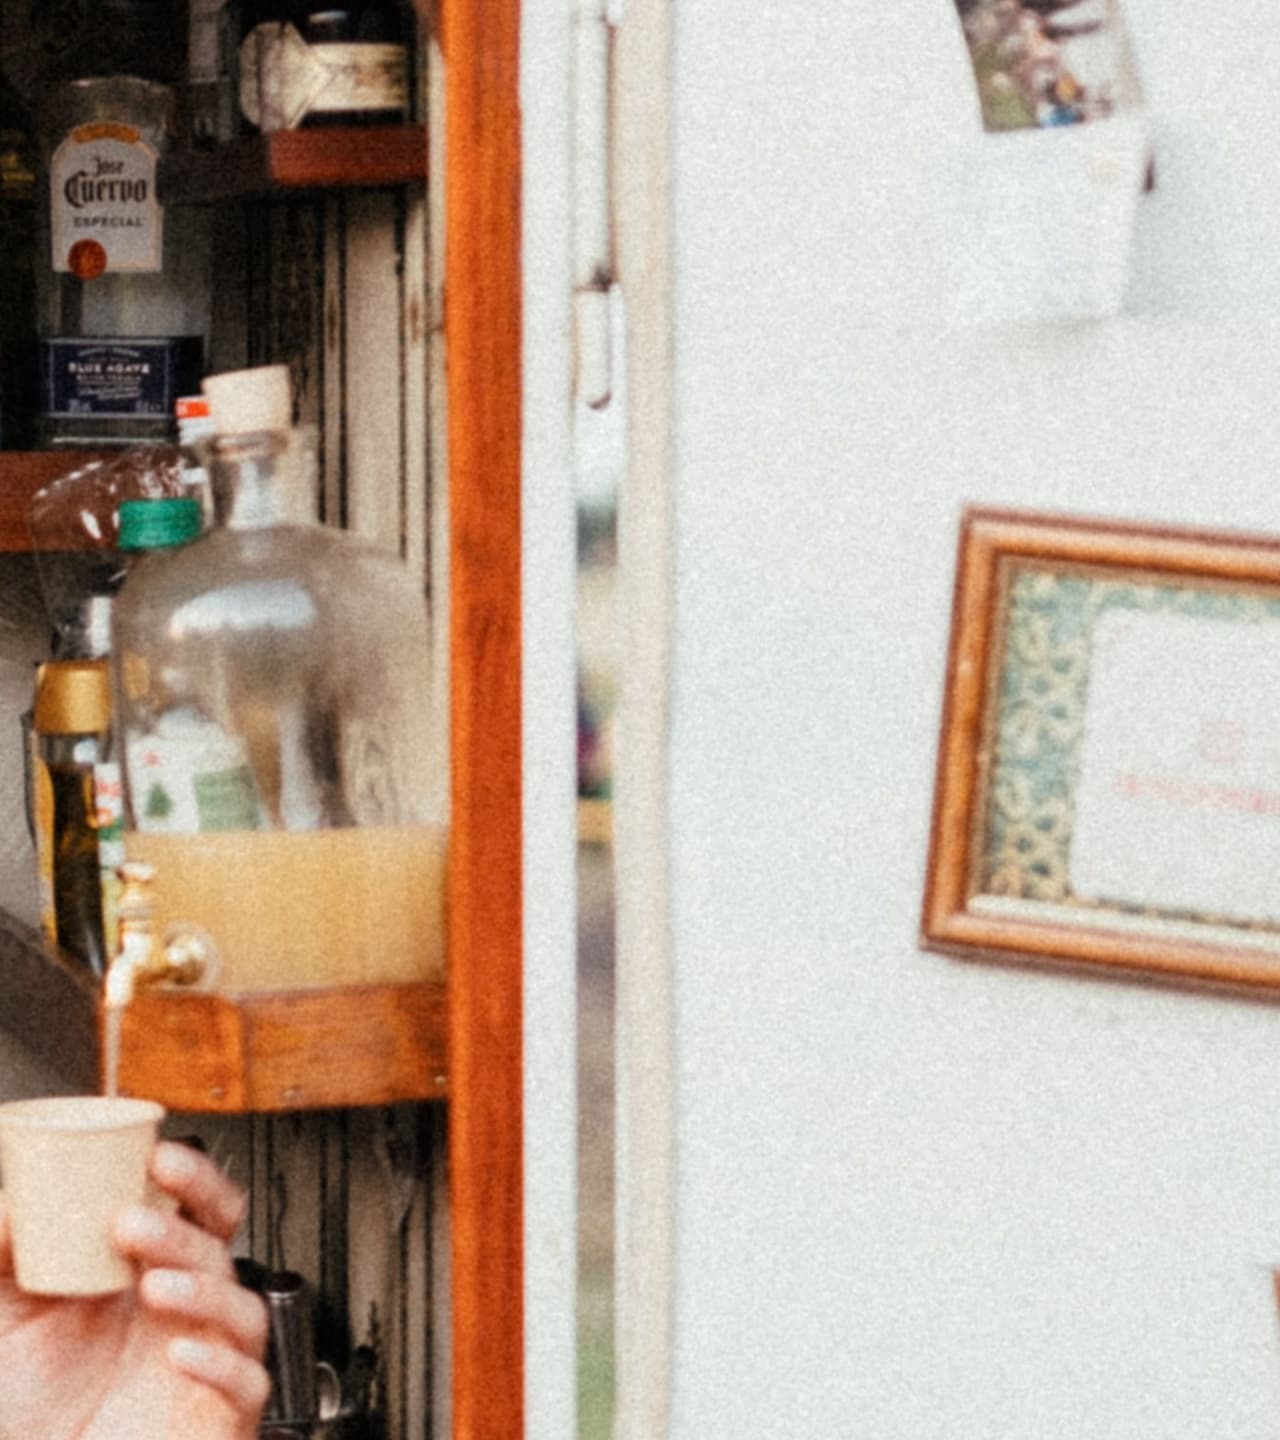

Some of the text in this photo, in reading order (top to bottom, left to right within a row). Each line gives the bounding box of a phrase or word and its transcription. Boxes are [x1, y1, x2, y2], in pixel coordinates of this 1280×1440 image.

[64, 170, 147, 209] Cuervo
[73, 216, 144, 228] ESPECIAL
[68, 362, 151, 375] BLUE AGAVE
